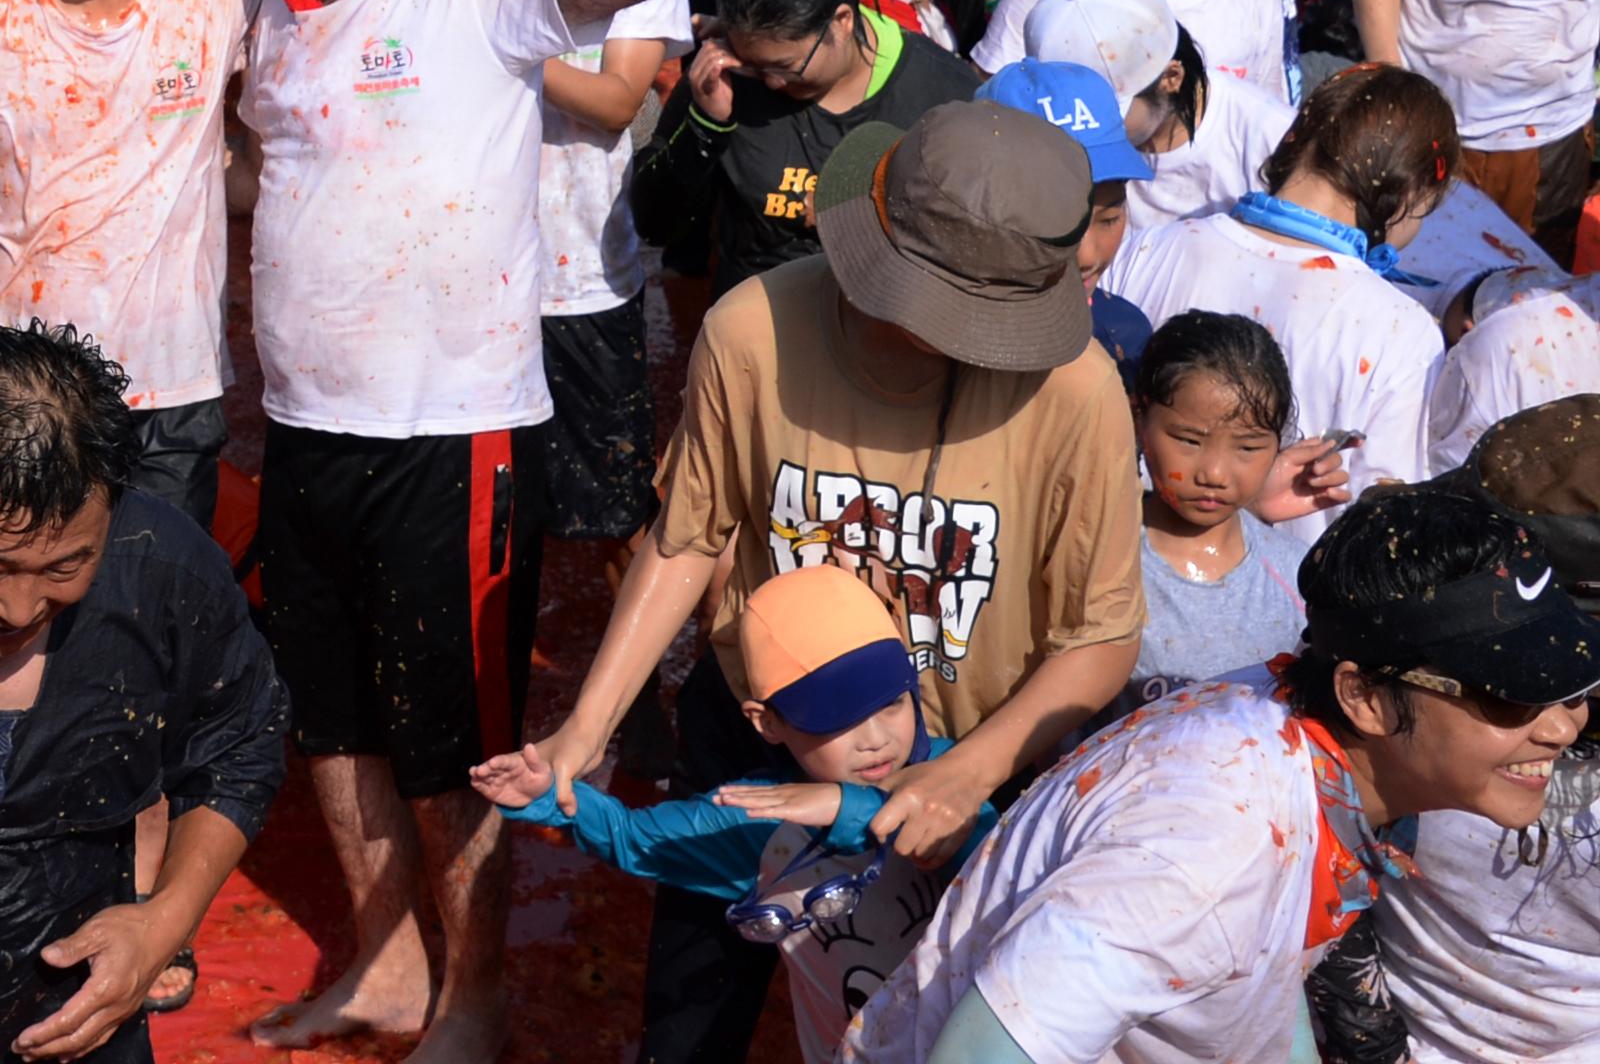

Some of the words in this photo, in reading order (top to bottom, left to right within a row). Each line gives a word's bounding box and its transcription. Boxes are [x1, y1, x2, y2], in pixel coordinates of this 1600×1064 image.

[361, 49, 406, 72] 토마토
[155, 72, 197, 96] 토마토
[1036, 96, 1100, 131] LA
